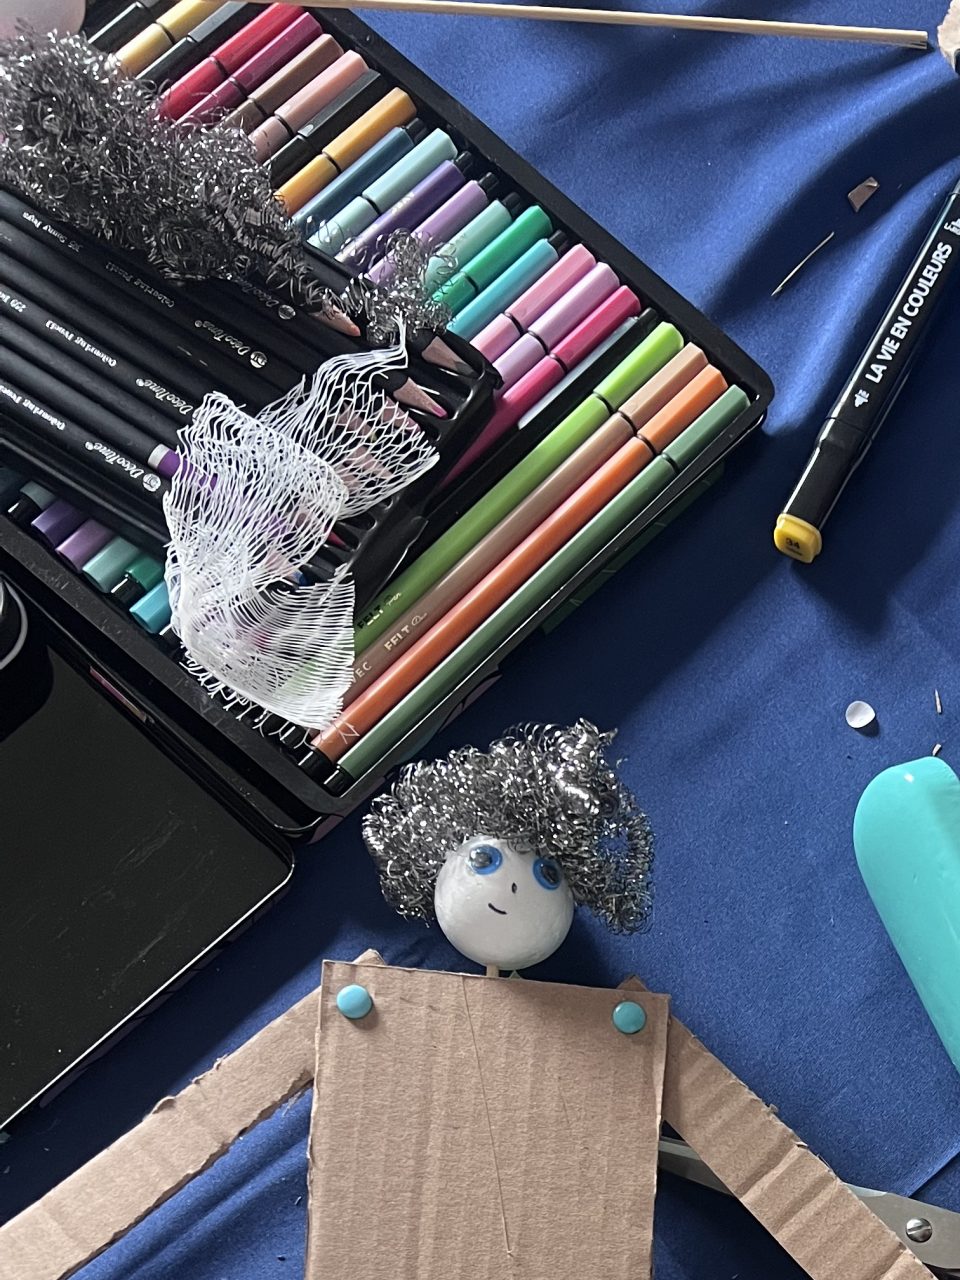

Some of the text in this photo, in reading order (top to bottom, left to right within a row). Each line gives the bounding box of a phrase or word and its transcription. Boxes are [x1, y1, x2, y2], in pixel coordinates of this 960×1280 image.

[899, 239, 955, 319] COULEURS
[888, 313, 913, 340] EN
[874, 335, 901, 364] VIE
[863, 358, 888, 385] LA
